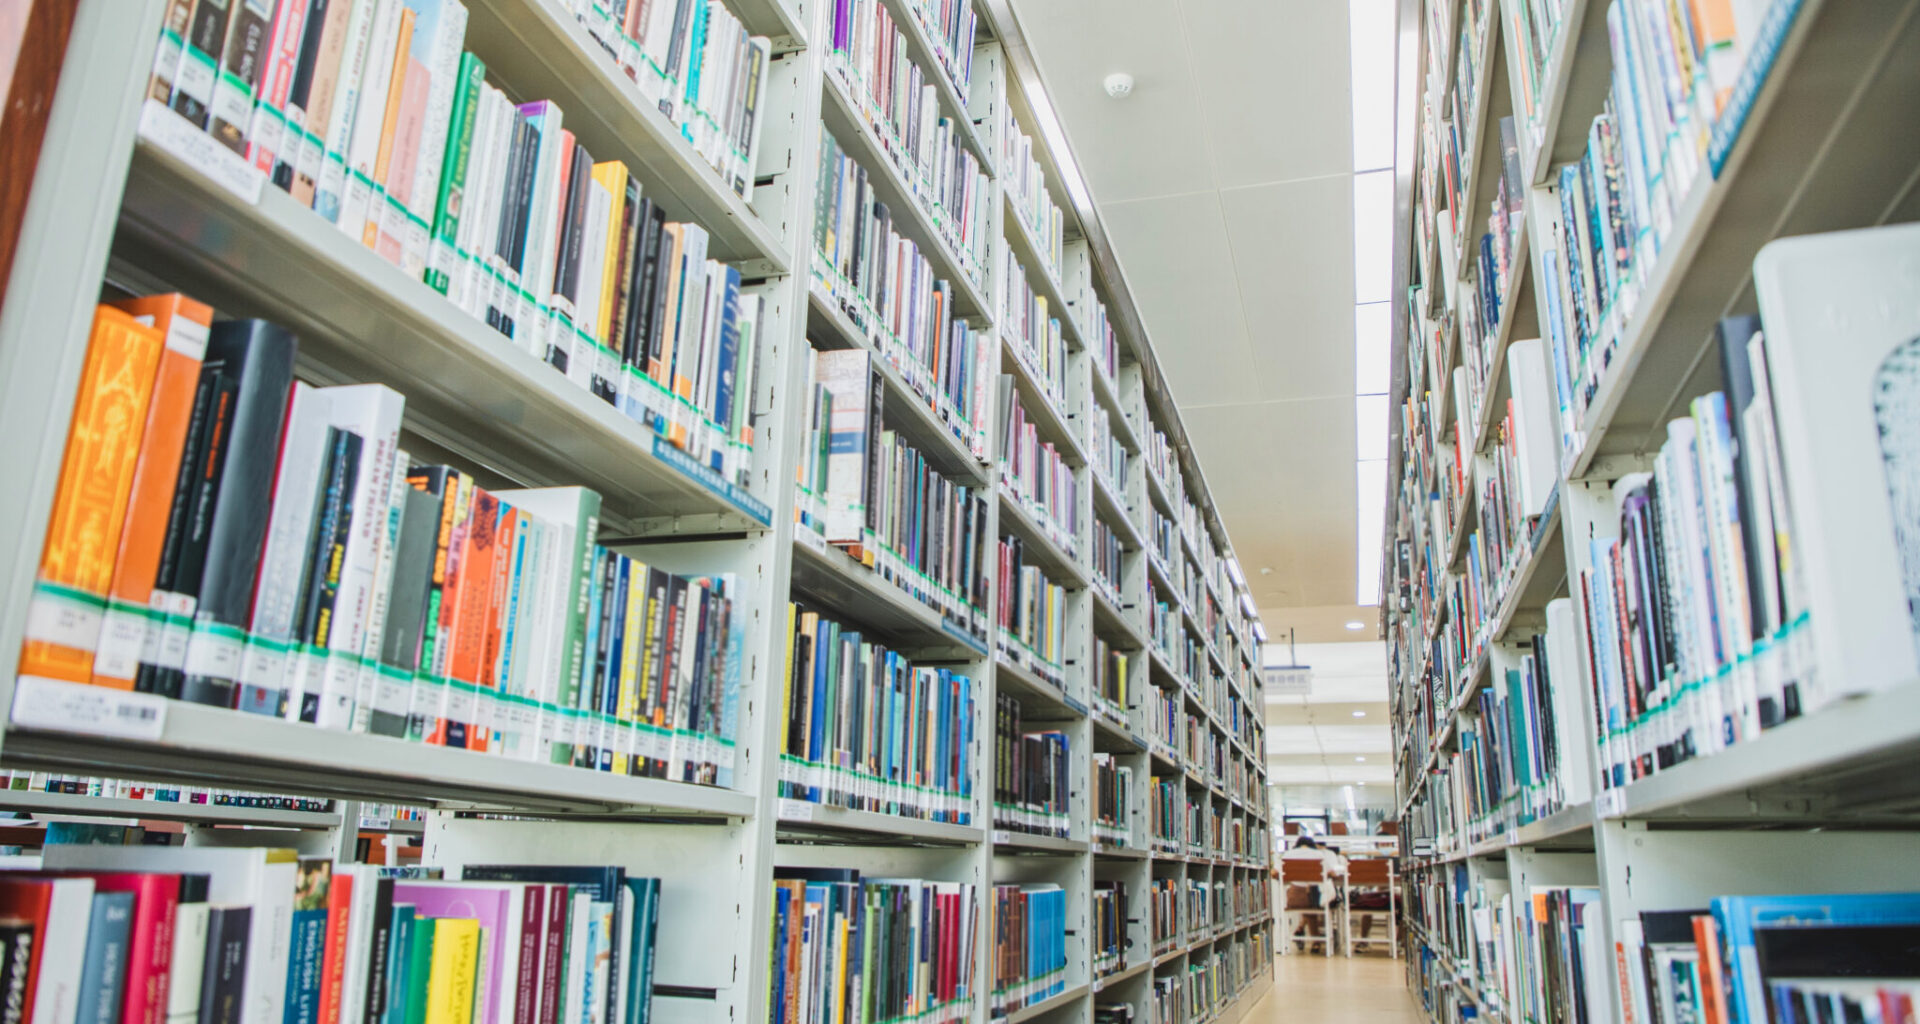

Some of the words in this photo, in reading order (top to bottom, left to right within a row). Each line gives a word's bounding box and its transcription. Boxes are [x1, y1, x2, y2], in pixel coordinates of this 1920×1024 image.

[653, 587, 665, 638] OFFERING
[677, 590, 686, 608] THE
[425, 590, 442, 637] EDGAR
[672, 610, 684, 649] LEGACY
[652, 641, 660, 654] TO
[671, 652, 680, 664] OF
[568, 640, 582, 686] JAVIER
[649, 657, 659, 677] THE
[669, 668, 679, 687] THE
[645, 680, 657, 717] STORM
